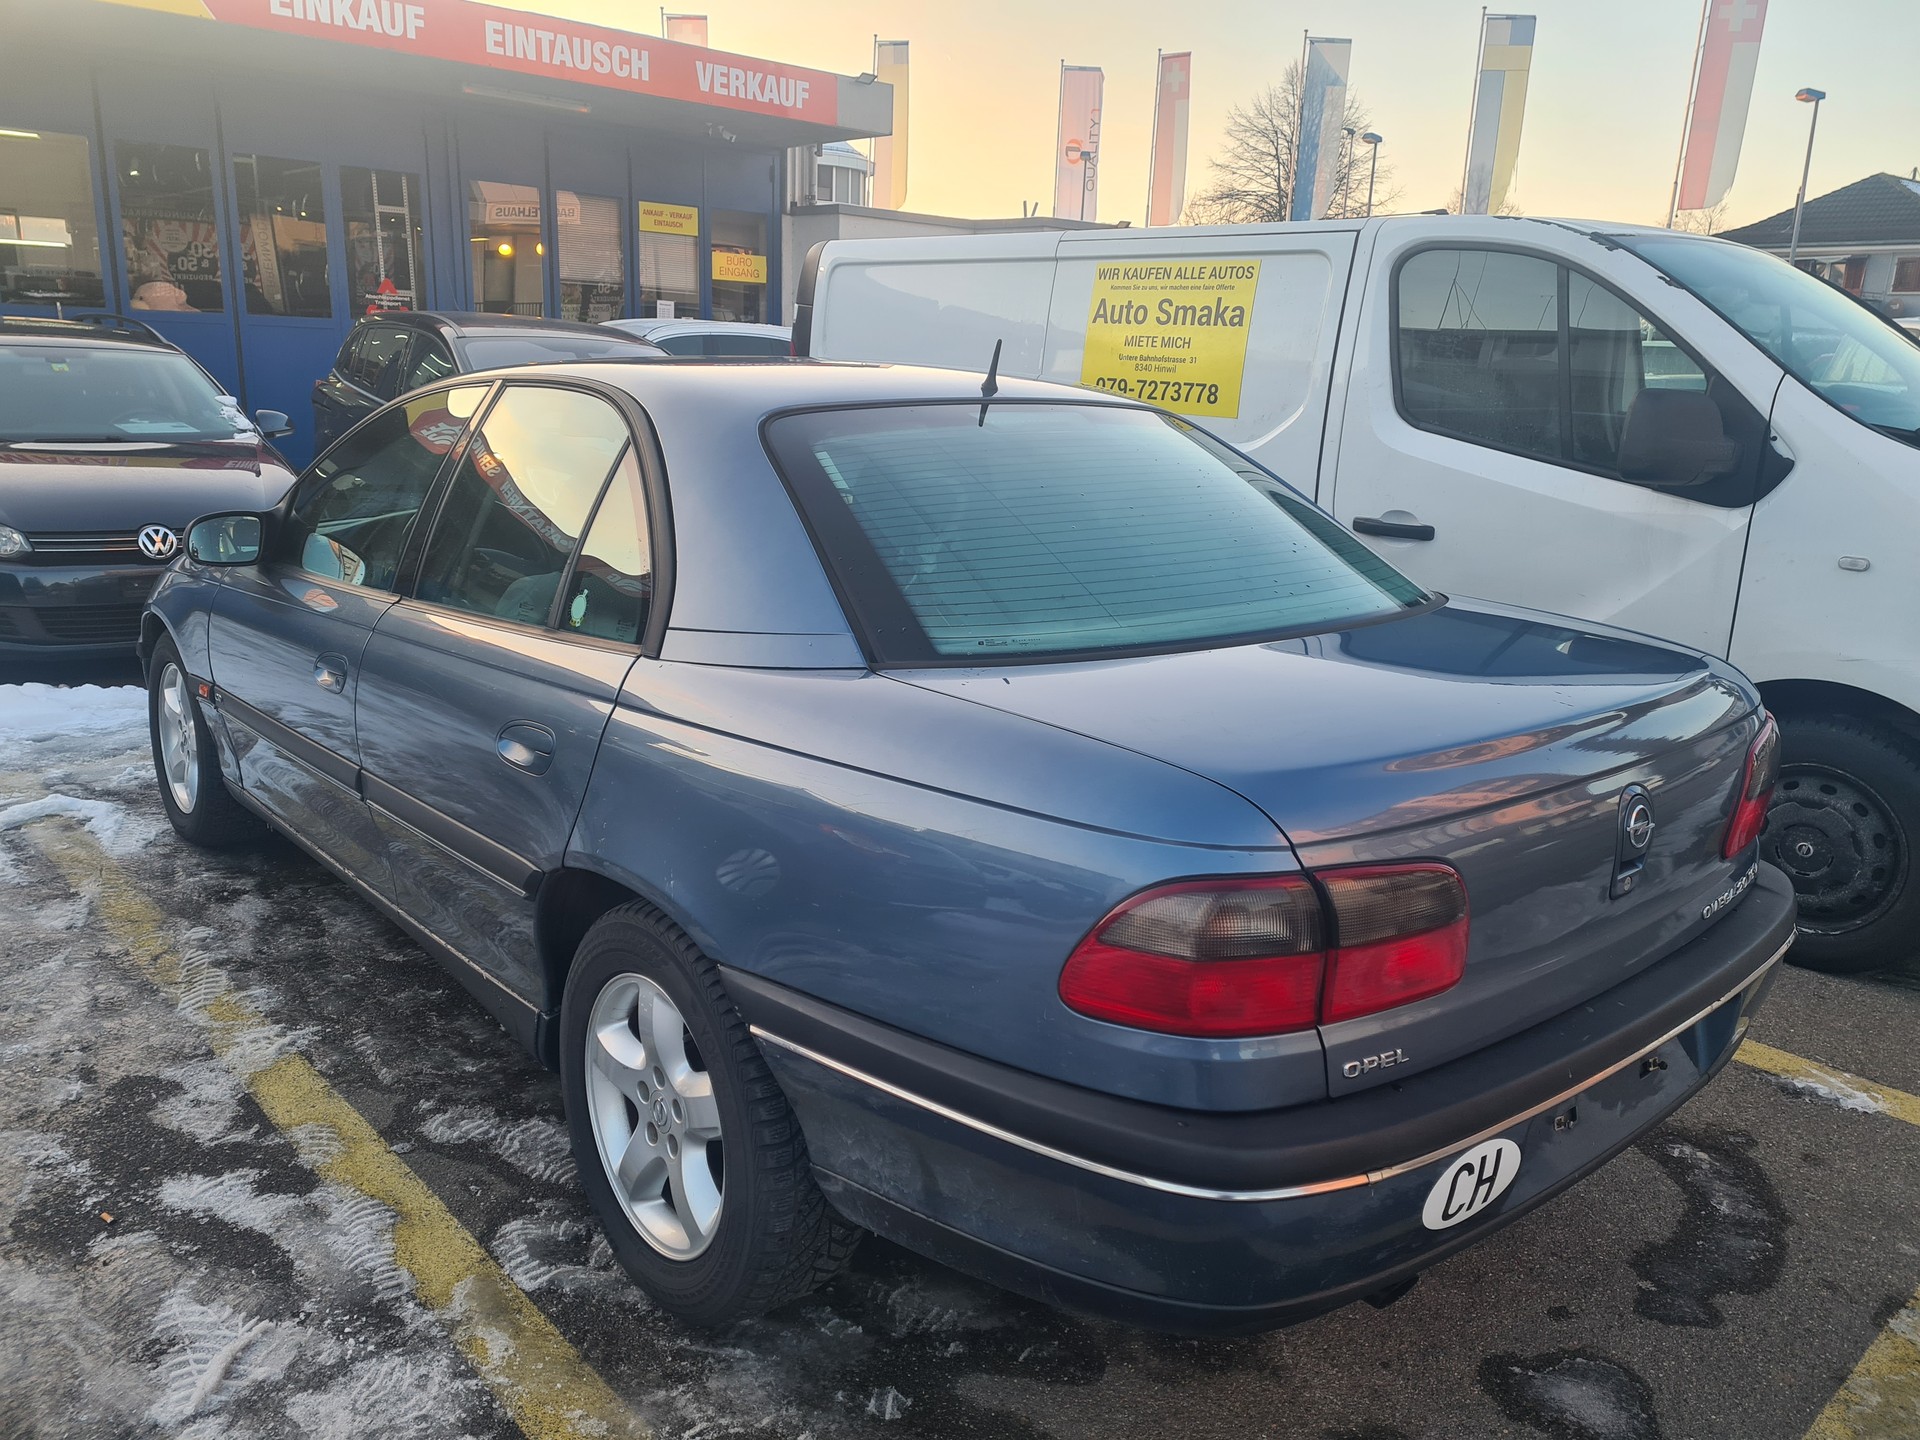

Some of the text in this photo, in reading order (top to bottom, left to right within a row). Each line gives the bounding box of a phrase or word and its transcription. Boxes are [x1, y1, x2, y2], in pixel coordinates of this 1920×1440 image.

[485, 19, 649, 81] EINTAUSCH
[696, 61, 810, 109] VERKAUF
[642, 208, 665, 217] ANKAUF
[669, 211, 693, 220] VERKAUF
[653, 219, 684, 229] EINTAUSCH
[726, 255, 753, 267] BÜRO
[719, 267, 760, 279] EINGANG
[1098, 266, 1255, 280] WIR KAUFEN ALLE AUTOS
[1092, 297, 1246, 327] Auto Smaka
[1124, 335, 1192, 349] MIETE MICH
[1118, 353, 1197, 364] Untere Bahnhofstrasse 31
[1134, 363, 1177, 374] 8340 Hinwil
[1344, 1048, 1410, 1078] OPEL
[1441, 1147, 1503, 1221] CH
